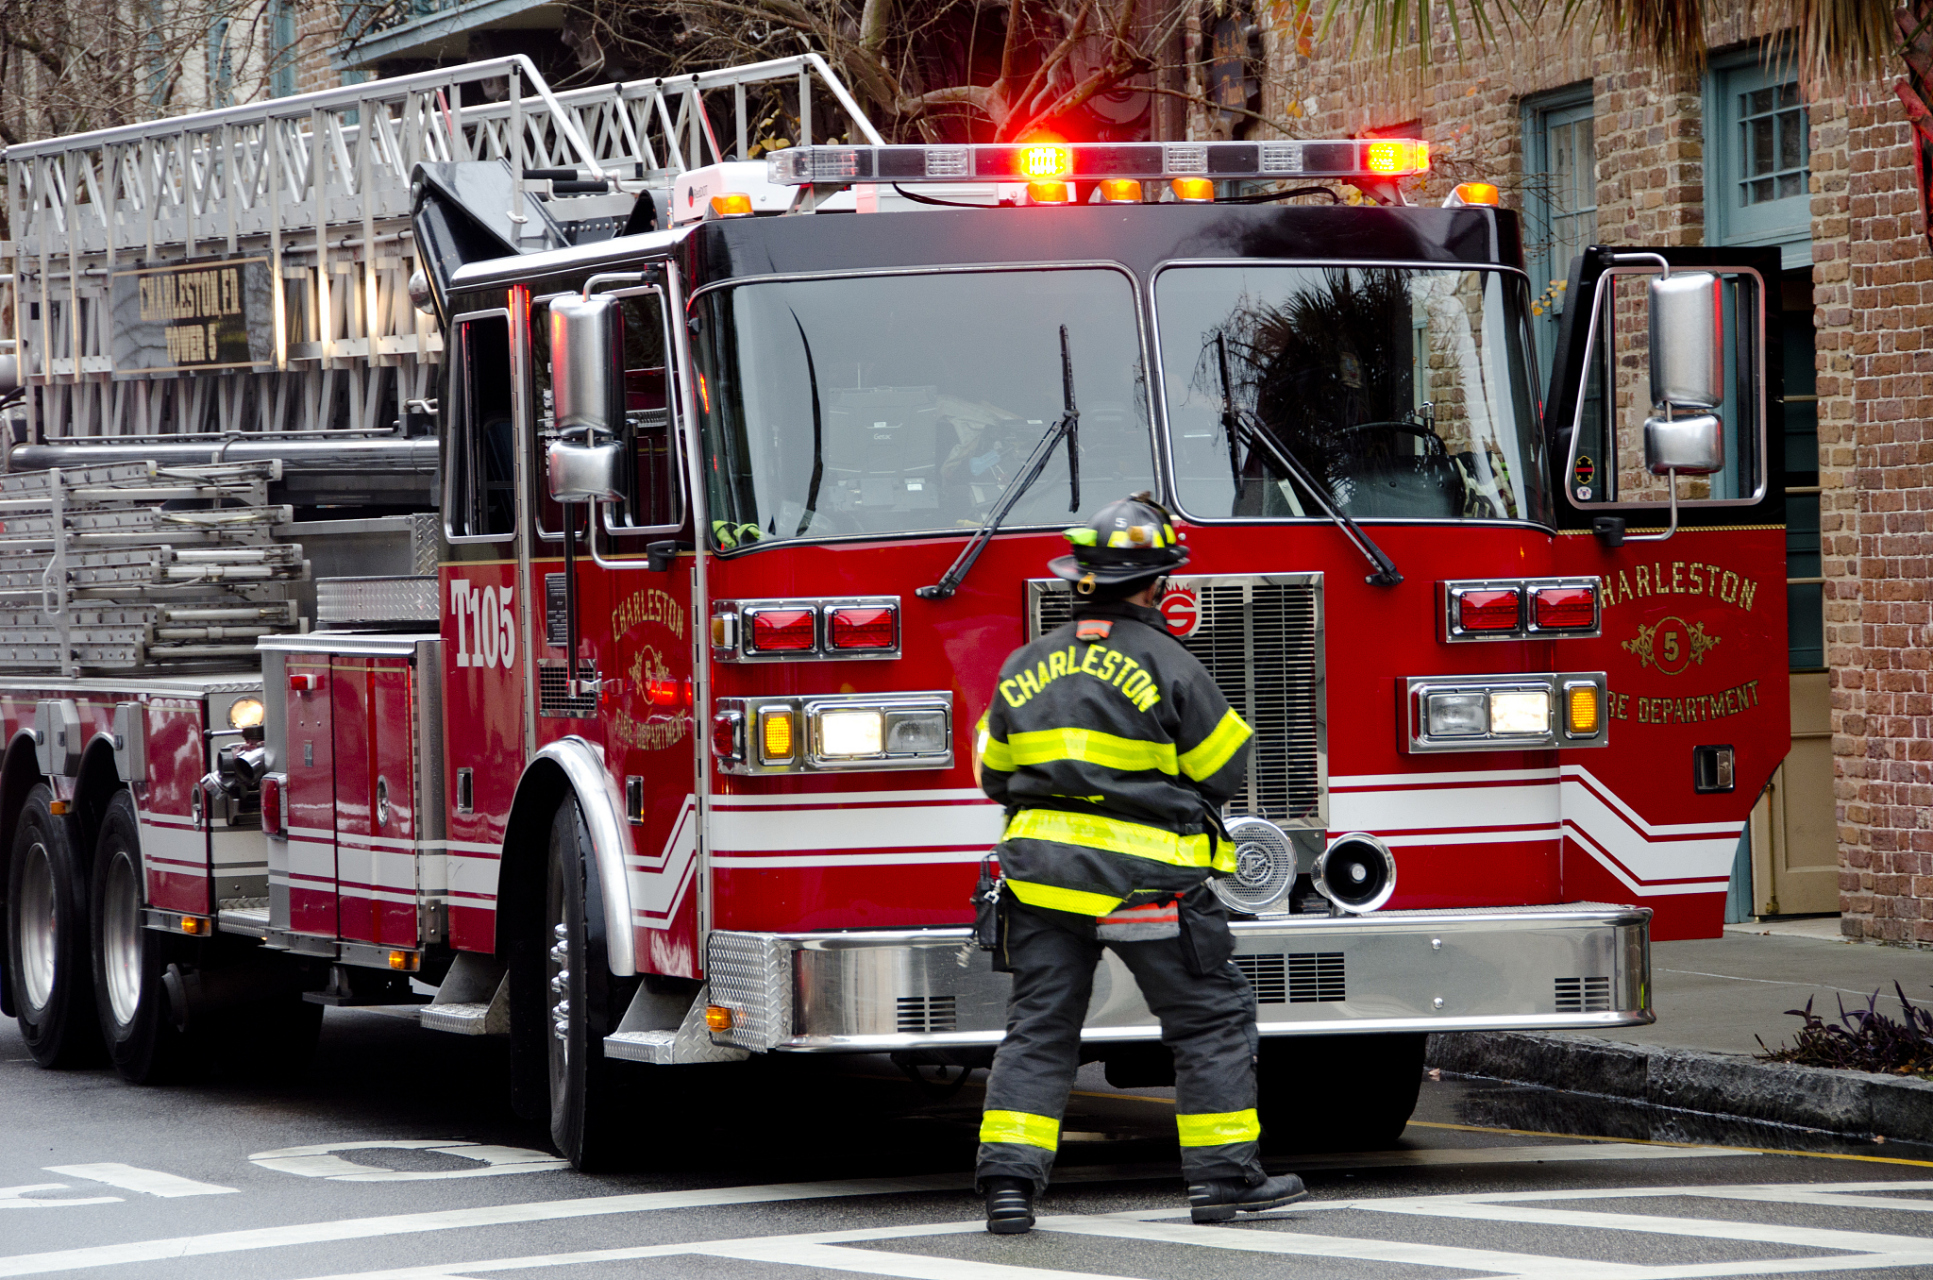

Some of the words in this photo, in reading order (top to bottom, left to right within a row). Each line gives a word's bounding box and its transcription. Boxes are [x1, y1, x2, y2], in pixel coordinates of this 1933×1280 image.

[165, 324, 206, 363] TOWER
[208, 323, 217, 361] 5
[1115, 517, 1128, 528] 5
[1600, 561, 1758, 612] HARLESTON
[450, 579, 515, 669] T105
[612, 588, 684, 643] CHARLESTON
[1663, 631, 1680, 662] 5
[645, 660, 652, 690] 5
[999, 643, 1162, 713] CHARLESTON
[1608, 690, 1630, 720] RE
[1637, 679, 1759, 724] DEPARTMENT
[614, 707, 634, 745] FIRE
[636, 708, 686, 751] DEPARTMENT
